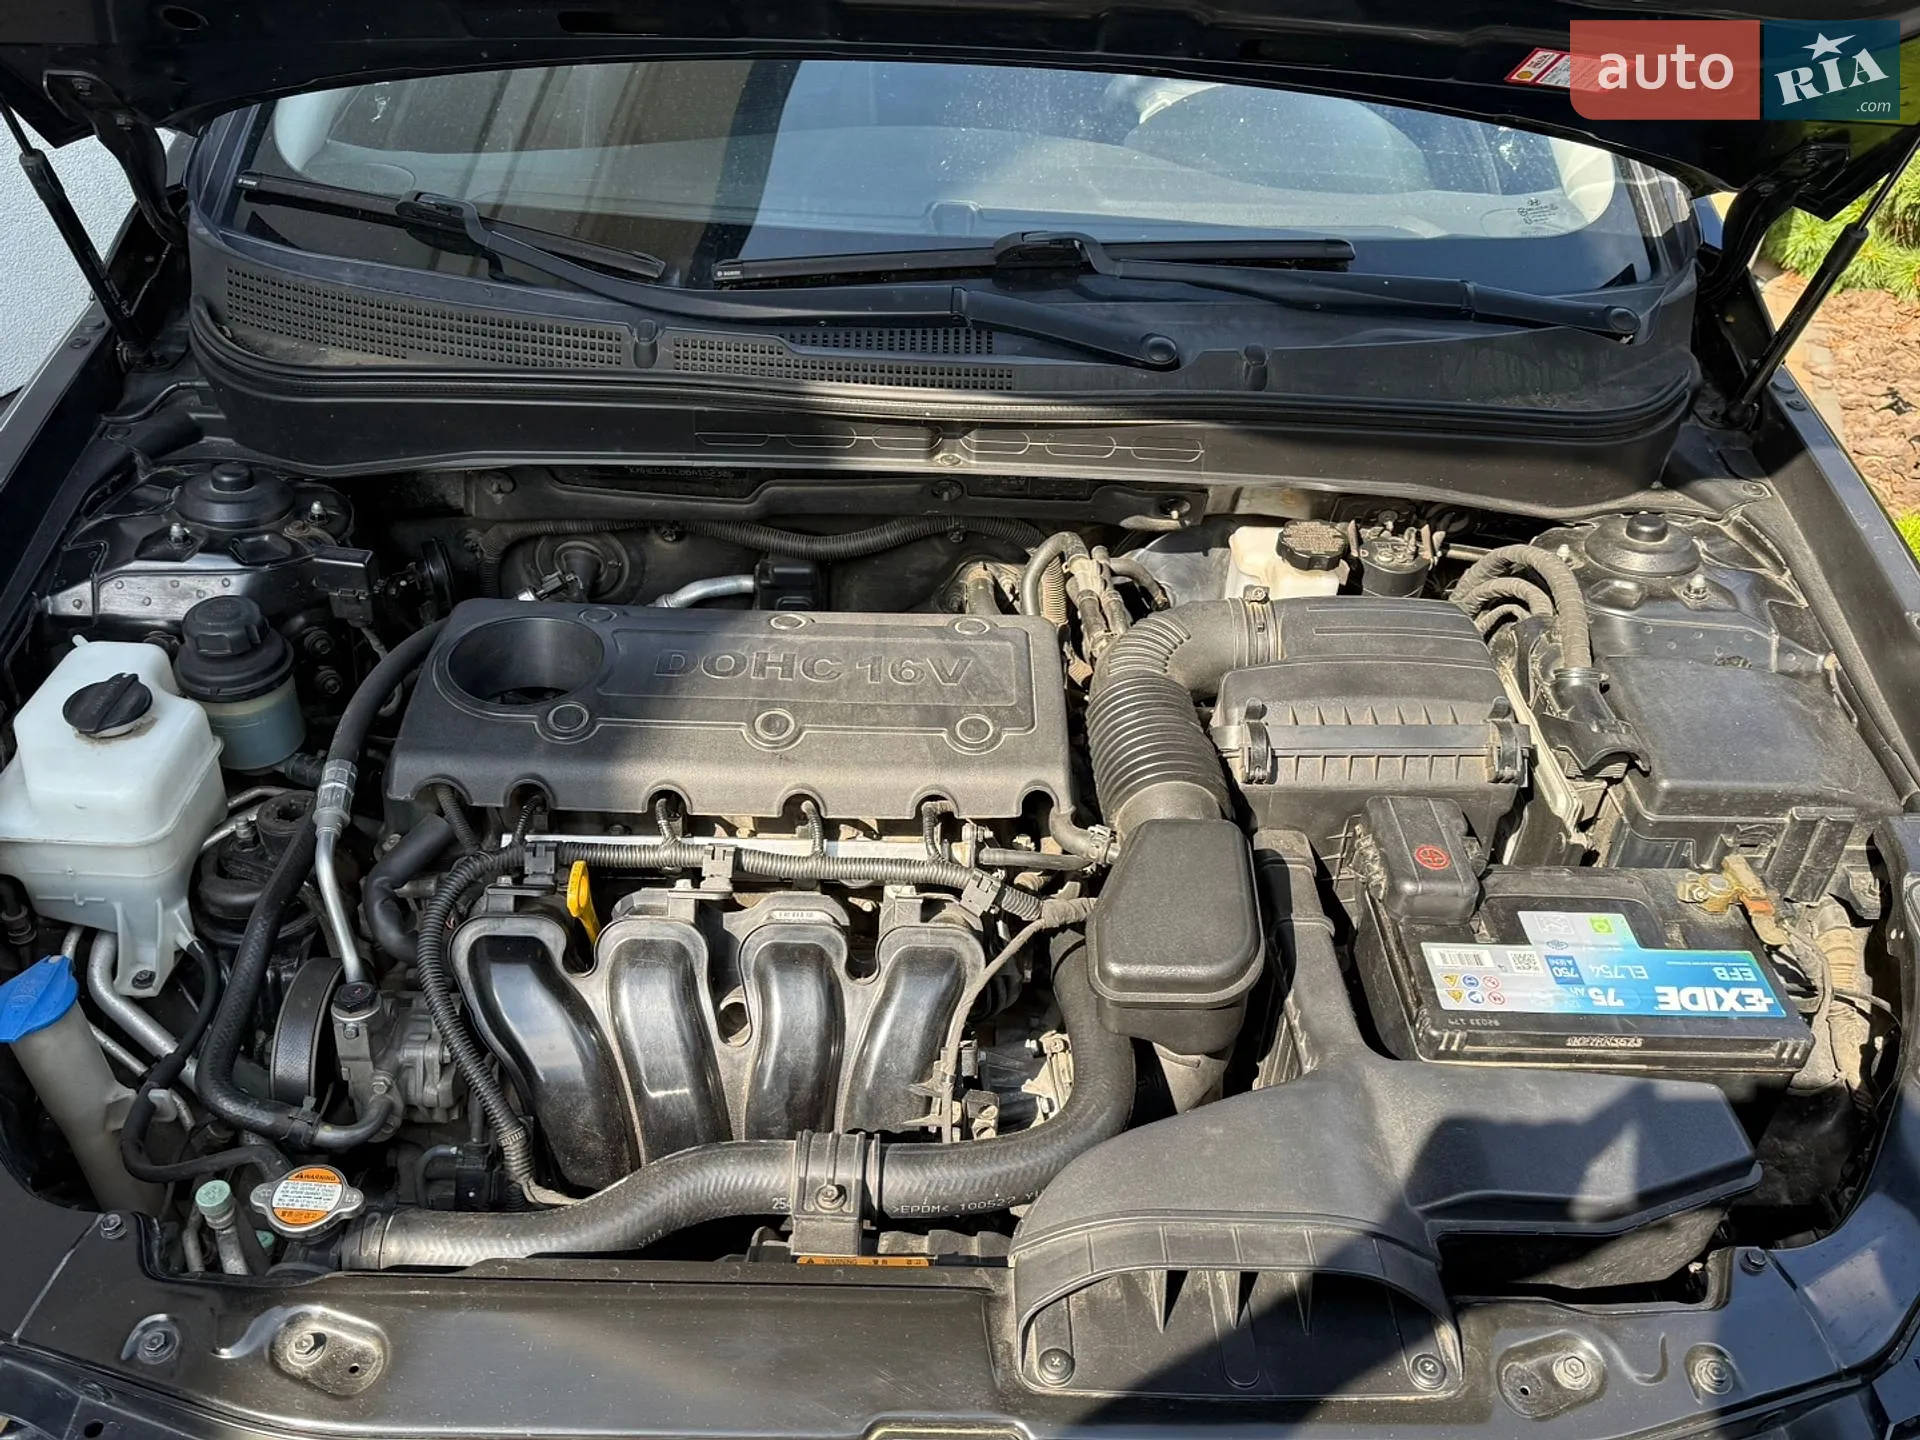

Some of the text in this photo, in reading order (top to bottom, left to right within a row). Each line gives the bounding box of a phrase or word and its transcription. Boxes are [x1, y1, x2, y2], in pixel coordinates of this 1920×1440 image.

[654, 649, 974, 687] DOHC 16V
[1552, 966, 1579, 978] 750
[1589, 965, 1649, 980] EL754
[1712, 966, 1757, 981] EFB
[1587, 987, 1625, 1007] 75
[1655, 986, 1774, 1012] EXIDE
